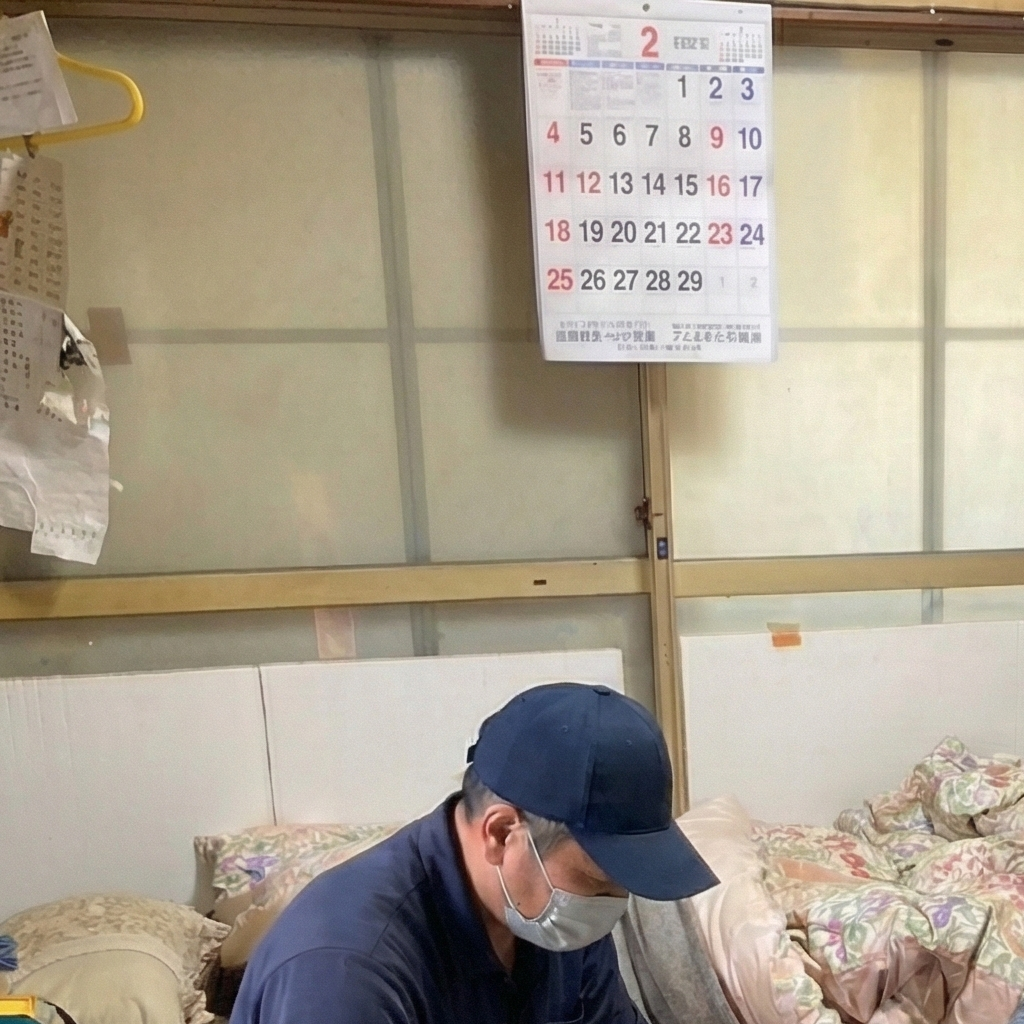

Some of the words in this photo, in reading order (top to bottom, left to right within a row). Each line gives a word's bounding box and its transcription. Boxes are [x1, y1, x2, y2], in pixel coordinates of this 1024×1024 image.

[640, 25, 659, 59] 2
[677, 74, 687, 98] 1
[708, 75, 723, 100] 2
[740, 77, 755, 101] 3
[546, 120, 560, 144] 4
[579, 121, 594, 146] 5
[612, 122, 627, 147] 6
[645, 124, 659, 147] 7
[678, 124, 692, 149] 8
[709, 125, 724, 149] 9
[737, 126, 762, 150] 10
[543, 169, 565, 194] 11
[576, 170, 602, 194] 12
[608, 171, 634, 195] 13
[641, 172, 667, 196] 14
[673, 172, 699, 197] 15
[706, 174, 731, 198] 16
[738, 174, 763, 198] 17
[544, 219, 571, 243] 18
[578, 219, 604, 243] 19
[610, 219, 637, 244] 20
[643, 220, 667, 244] 21
[675, 221, 702, 244] 22
[707, 222, 734, 246] 23
[739, 222, 765, 246] 24
[547, 268, 574, 291] 25
[580, 268, 607, 291] 26
[613, 268, 639, 291] 27
[645, 269, 671, 292] 28
[677, 269, 703, 292] 29
